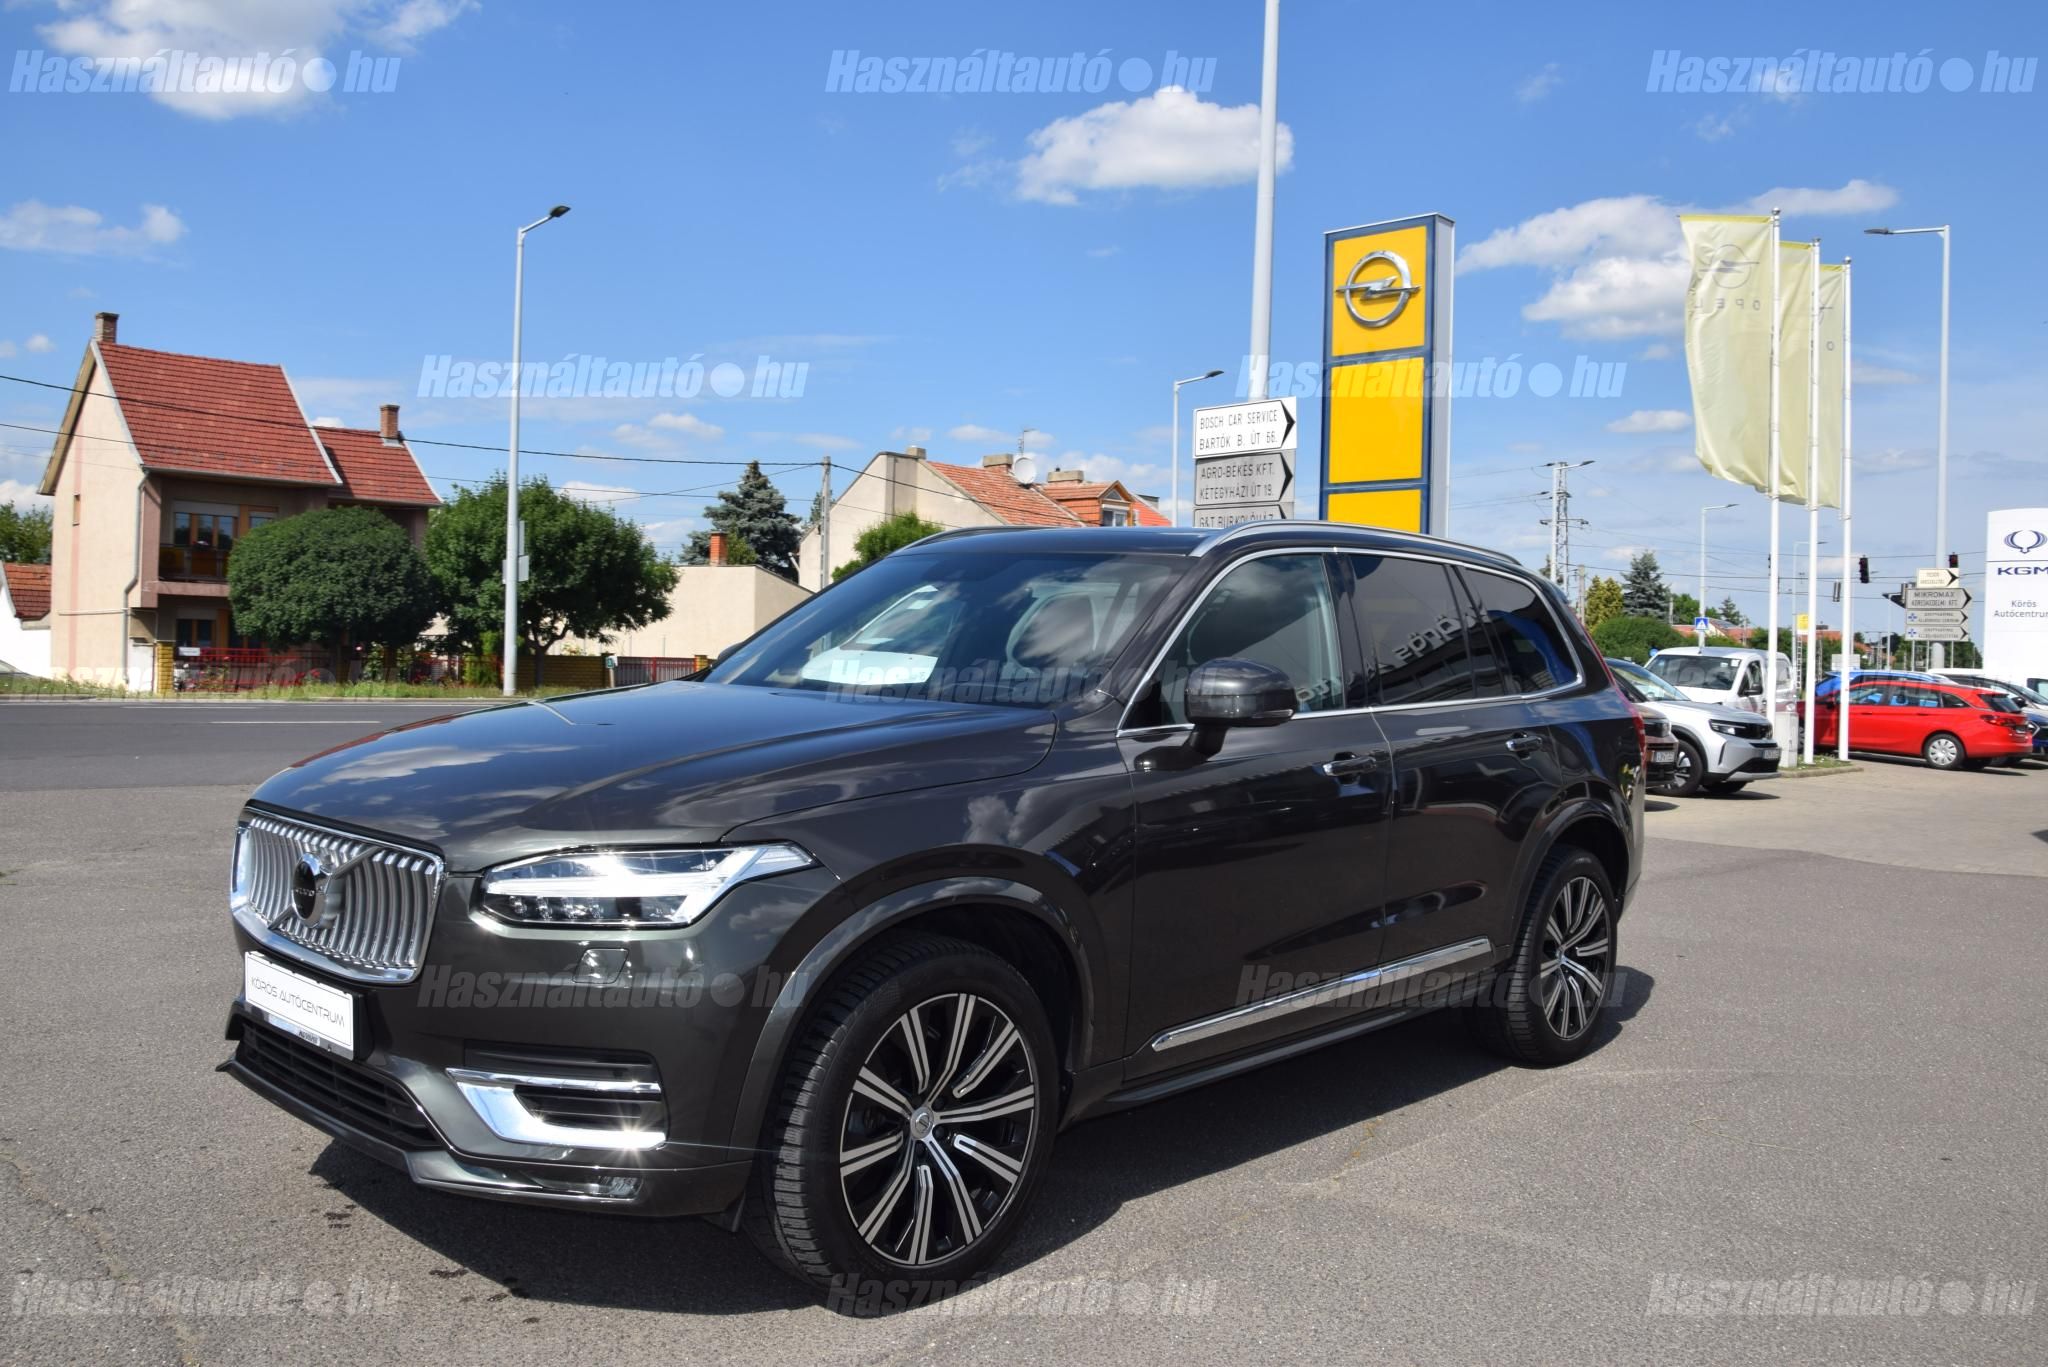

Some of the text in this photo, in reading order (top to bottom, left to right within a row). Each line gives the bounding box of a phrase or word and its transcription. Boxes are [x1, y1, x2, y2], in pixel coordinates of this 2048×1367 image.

[1200, 409, 1278, 430] BOSCH CAR SERVICE
[1199, 433, 1231, 450] BARTÓK
[1201, 462, 1253, 479] AGRO-BÉKÉS
[1200, 482, 1249, 500] KÉTEGYHÁZI
[1997, 566, 2048, 576] KGM
[1993, 609, 2048, 618] Autócentru
